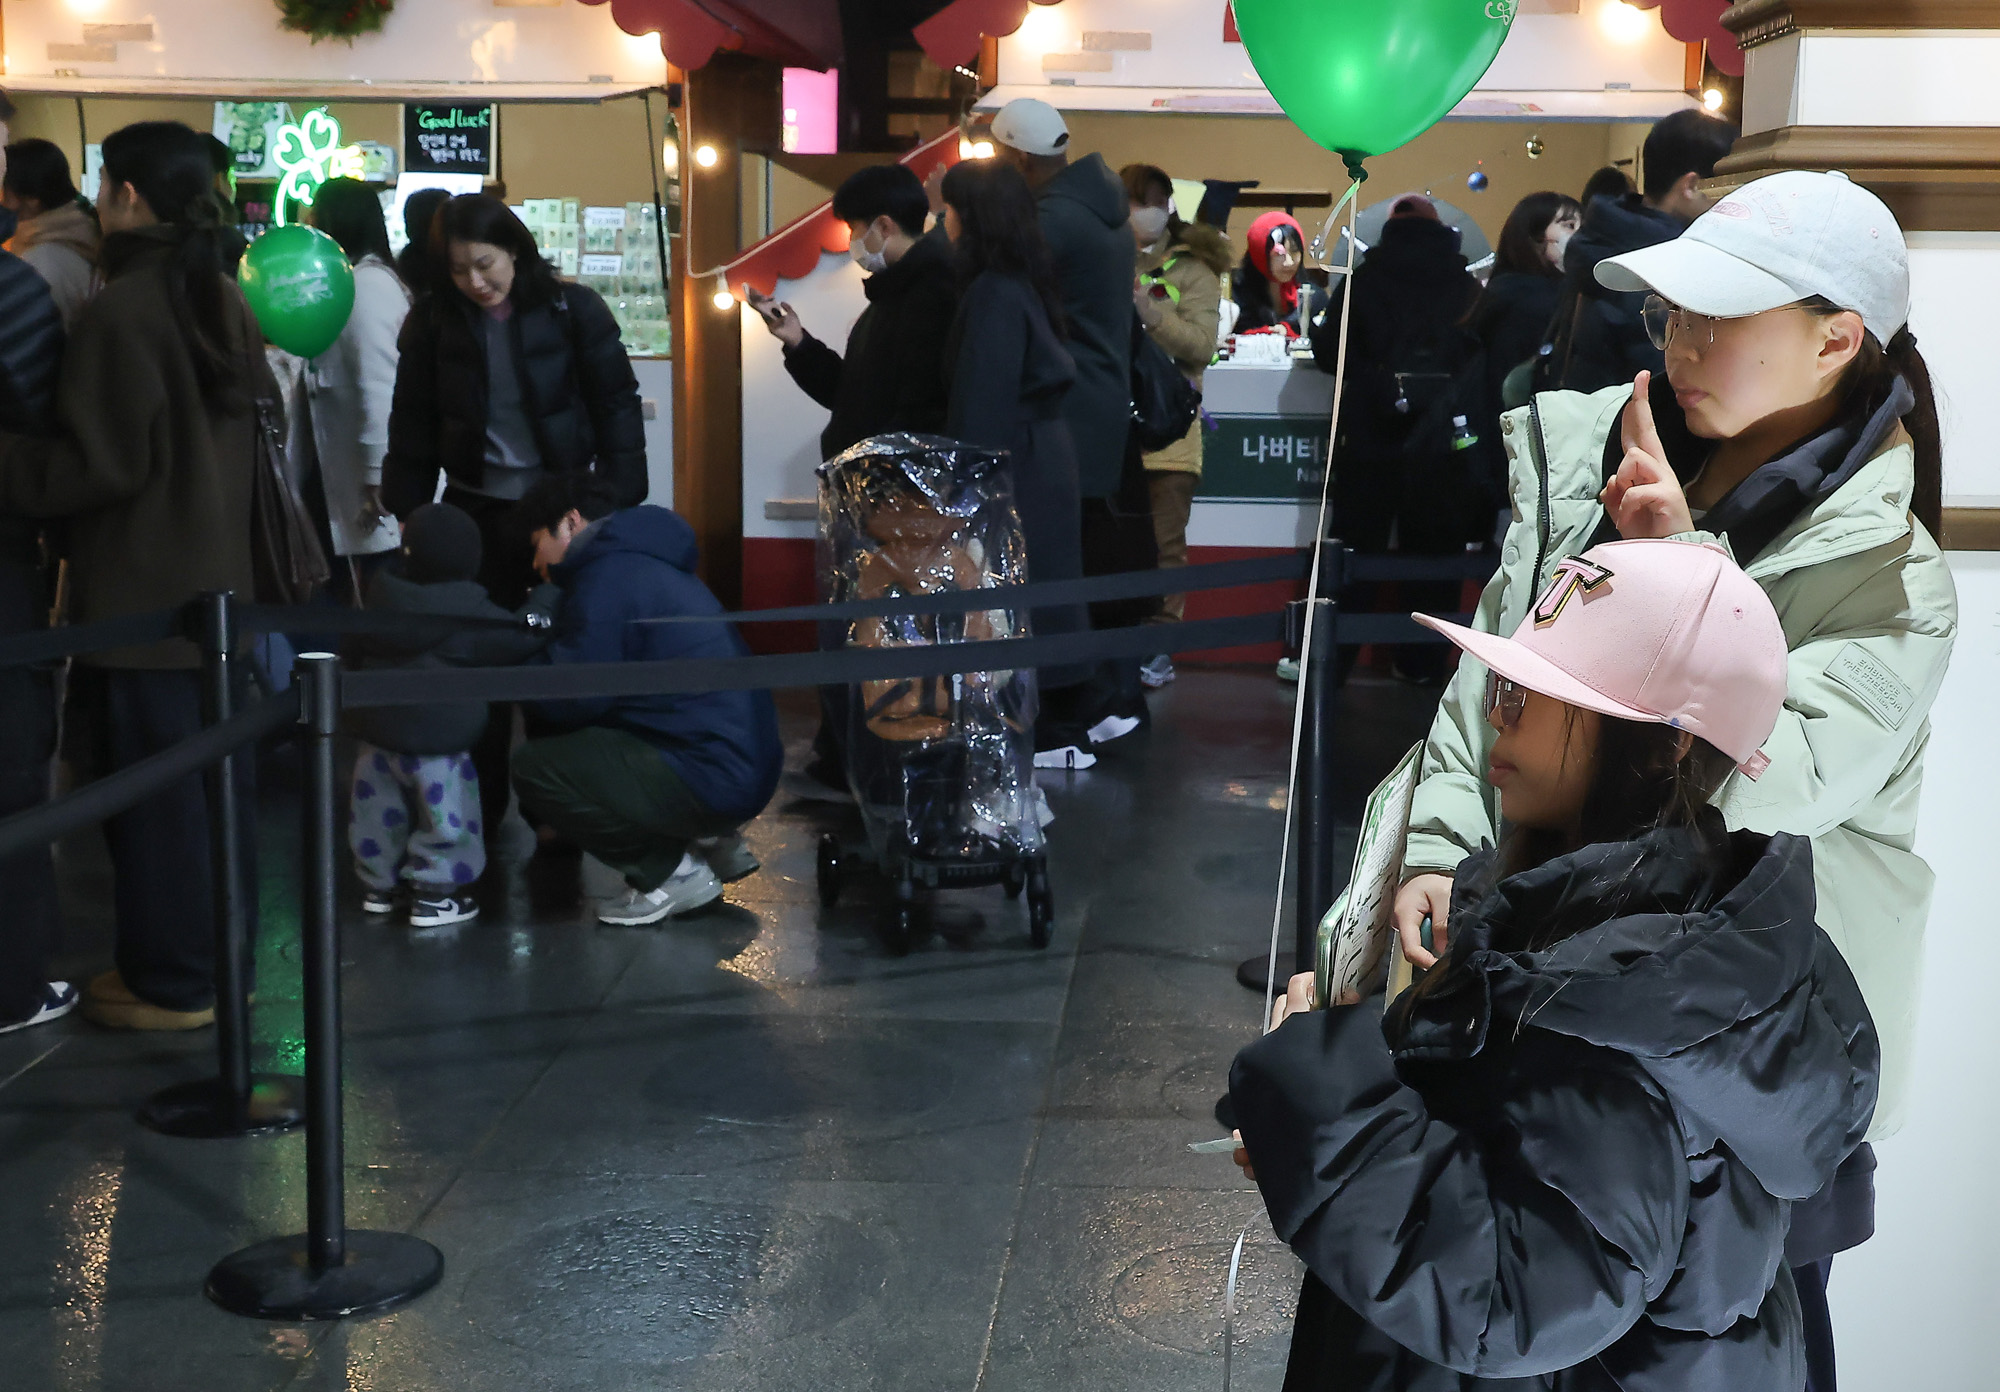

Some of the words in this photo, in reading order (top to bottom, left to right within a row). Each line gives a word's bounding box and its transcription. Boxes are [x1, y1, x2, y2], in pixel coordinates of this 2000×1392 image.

[1843, 657, 1862, 677] THE
[1861, 673, 1904, 713] FREEDOM
[1859, 659, 1901, 697] EMBRACE
